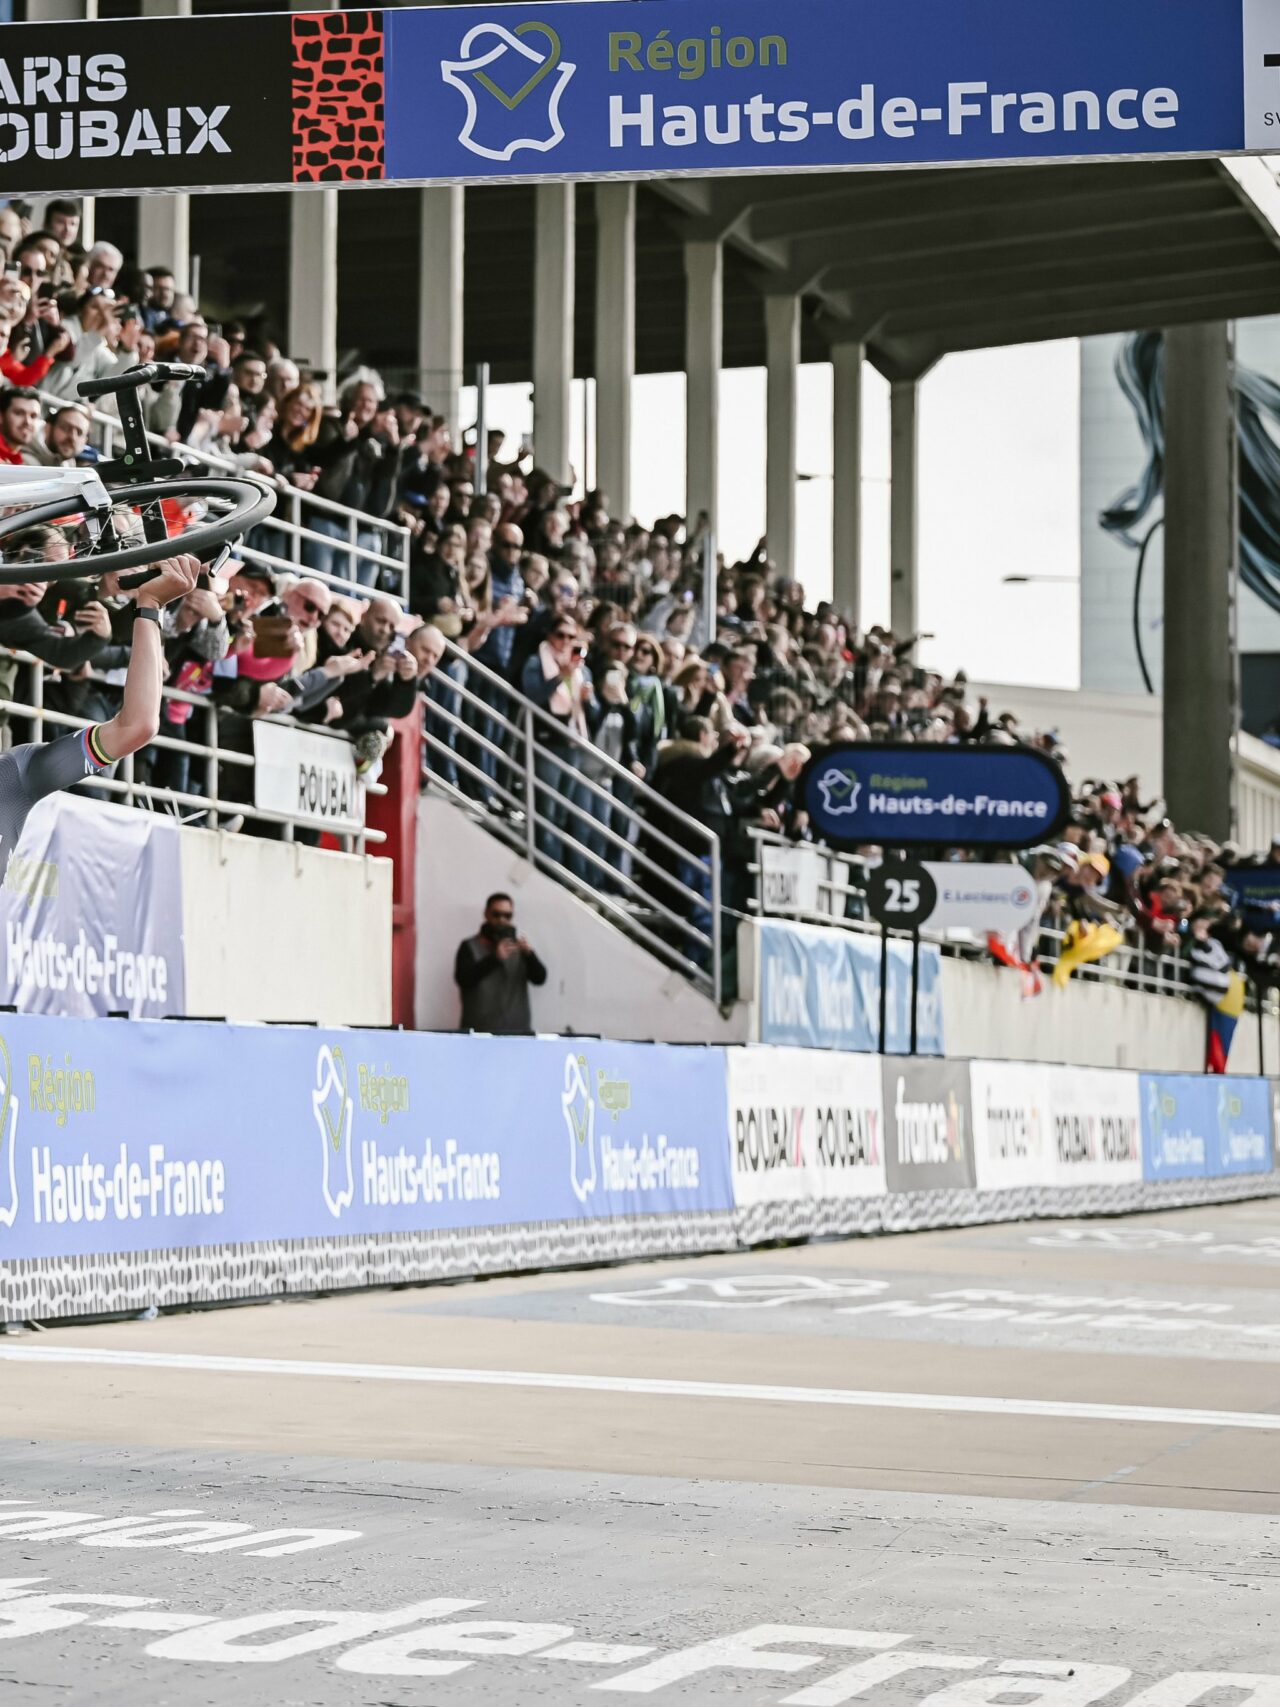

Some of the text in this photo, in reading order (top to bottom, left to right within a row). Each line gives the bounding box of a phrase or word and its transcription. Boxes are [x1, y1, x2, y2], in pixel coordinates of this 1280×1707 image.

[608, 25, 788, 79] Région
[609, 82, 1179, 148] Hauts-de-France
[869, 794, 1048, 818] Hauts-de-France
[884, 879, 920, 912] 25
[6, 921, 168, 1002] Hauts-de-France
[28, 1053, 96, 1128] Région
[31, 1142, 225, 1224] Hauts-de-France
[361, 1137, 500, 1205] Hauts-de-France
